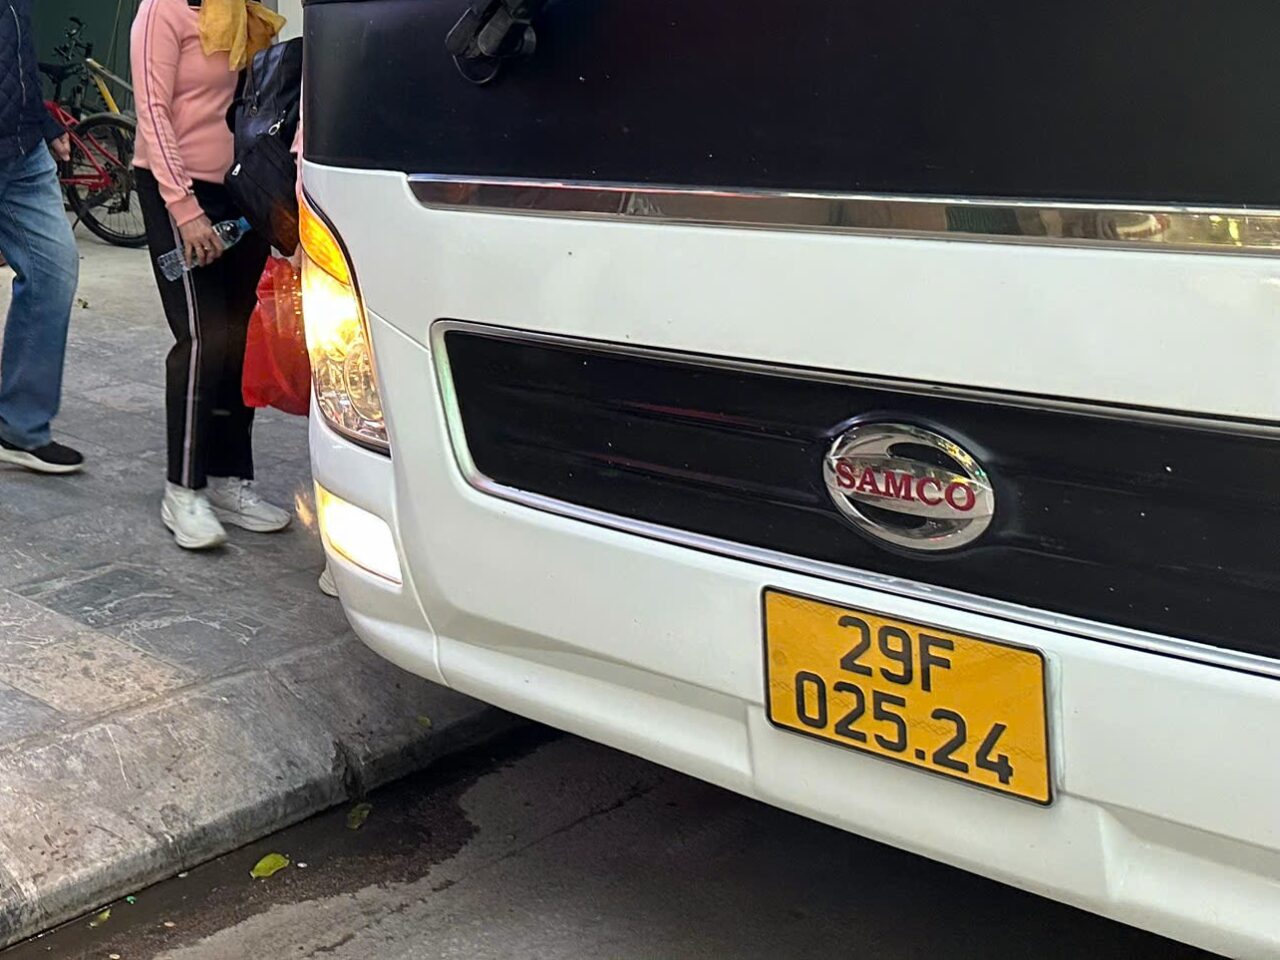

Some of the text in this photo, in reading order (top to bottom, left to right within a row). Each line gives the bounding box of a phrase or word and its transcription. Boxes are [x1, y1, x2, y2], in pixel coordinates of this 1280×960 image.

[835, 457, 977, 513] SAMCO
[837, 614, 956, 694] 29F
[794, 669, 1015, 785] 025.24
